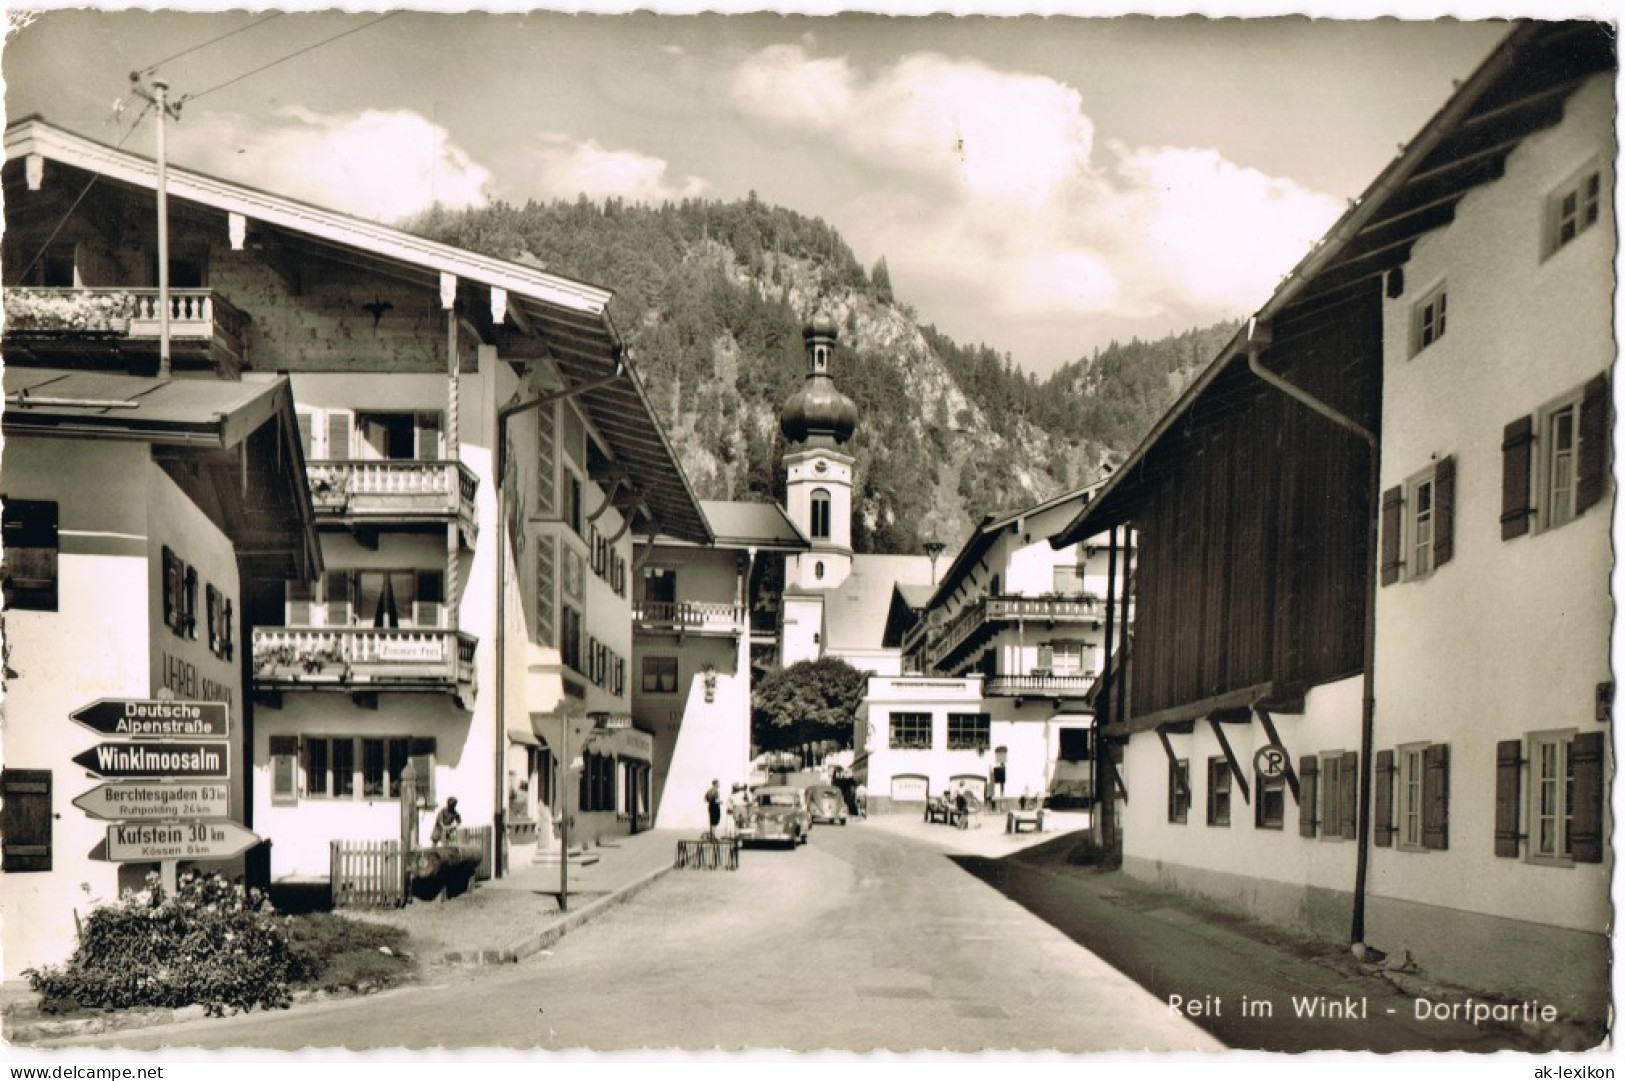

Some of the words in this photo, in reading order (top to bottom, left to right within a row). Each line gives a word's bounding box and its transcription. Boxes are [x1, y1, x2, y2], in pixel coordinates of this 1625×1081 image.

[125, 703, 200, 718] Deutsche
[115, 718, 213, 736] Alpenstraße
[98, 747, 219, 770] Winklmoosalm
[105, 787, 198, 804] Berchtesgaden
[202, 787, 215, 801] 63
[117, 824, 183, 845] Kufstein
[188, 824, 207, 843] 30
[211, 827, 225, 842] km
